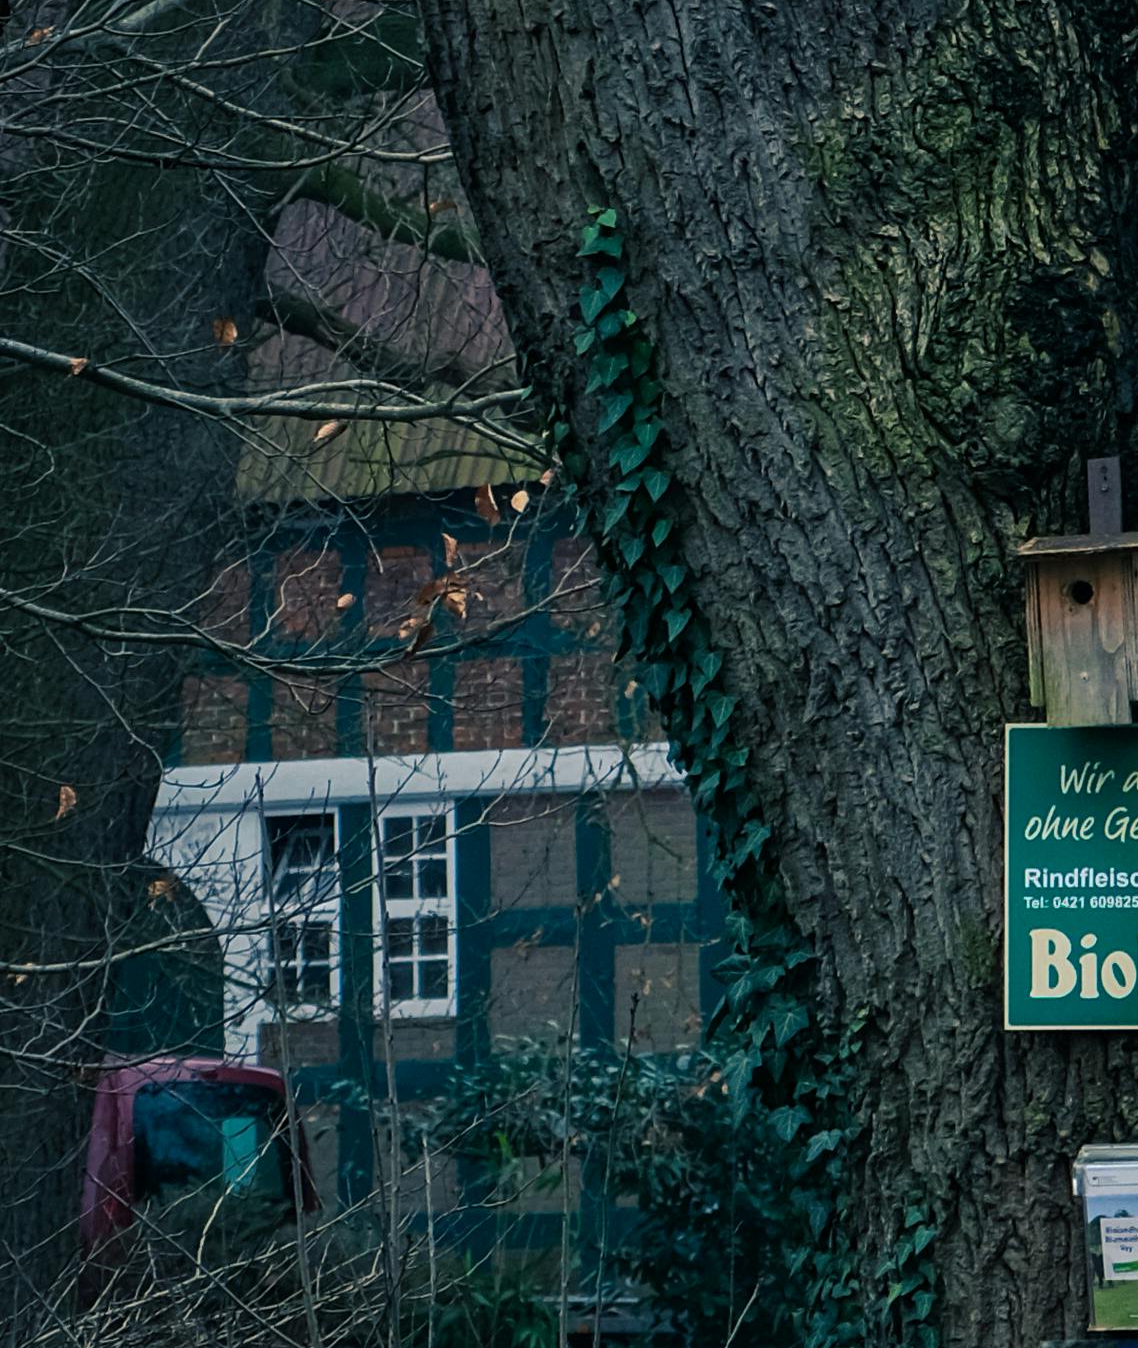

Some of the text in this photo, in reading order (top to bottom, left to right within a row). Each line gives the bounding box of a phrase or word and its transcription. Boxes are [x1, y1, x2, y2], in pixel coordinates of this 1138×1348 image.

[1060, 761, 1115, 794] Wir
[1024, 805, 1094, 841] ohne
[1053, 896, 1085, 909] 0421
